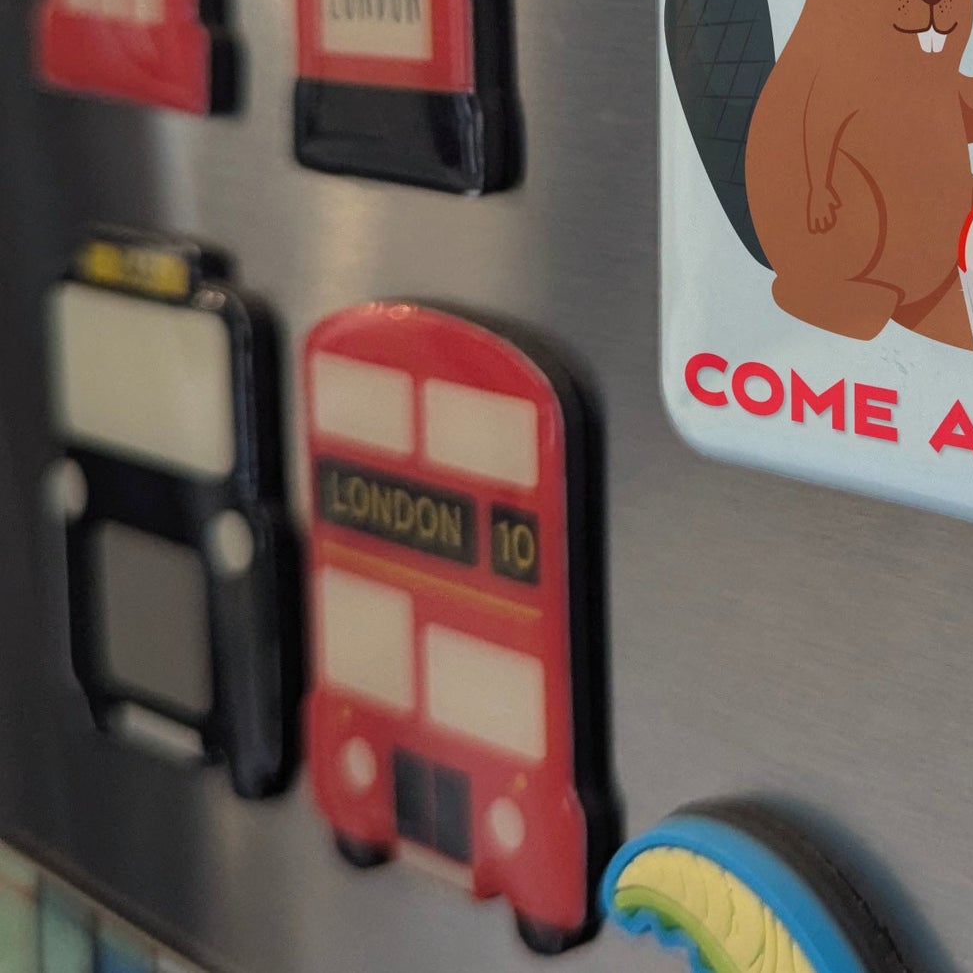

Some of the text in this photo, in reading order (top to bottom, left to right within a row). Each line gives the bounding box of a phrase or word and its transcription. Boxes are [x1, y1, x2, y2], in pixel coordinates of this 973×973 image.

[684, 352, 899, 443] COME
[328, 471, 535, 570] LONDON 10
